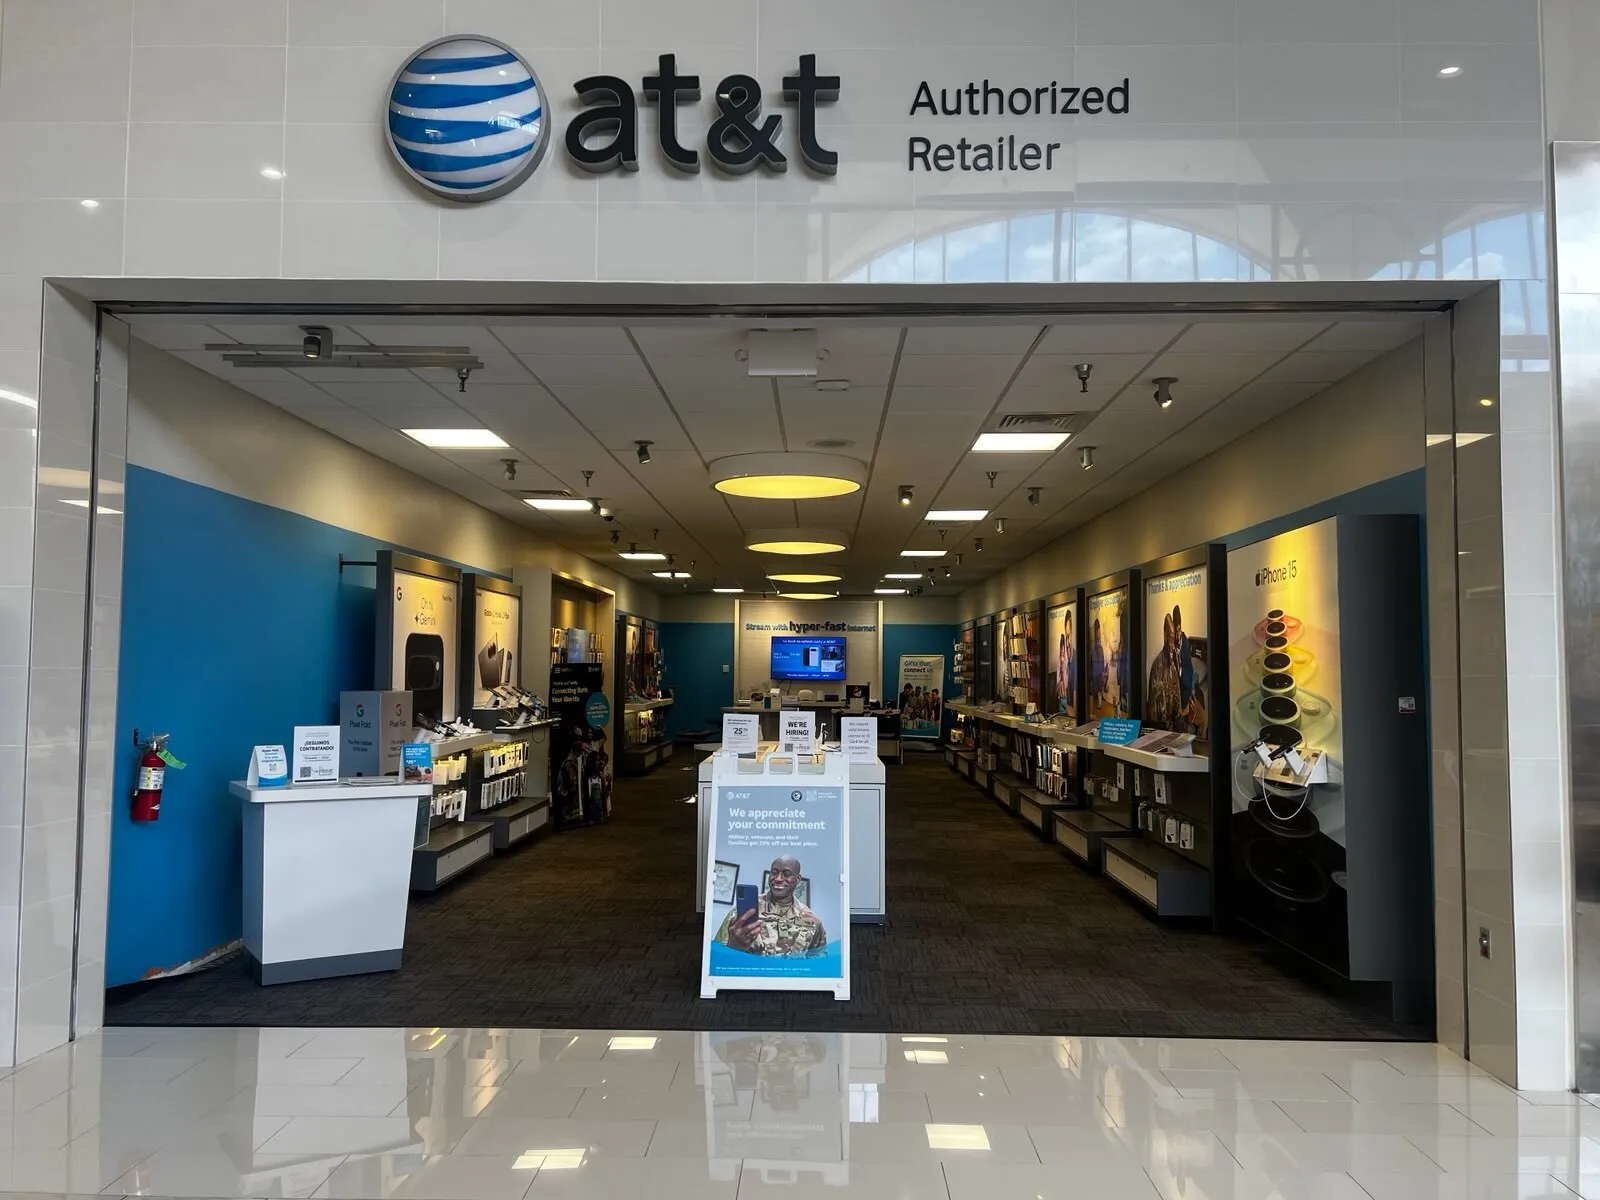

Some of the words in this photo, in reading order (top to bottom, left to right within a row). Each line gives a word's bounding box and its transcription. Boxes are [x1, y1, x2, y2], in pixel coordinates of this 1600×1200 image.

[909, 79, 1131, 115] Authorized
[565, 53, 841, 175] at&t
[908, 136, 1061, 171] Retailer
[1261, 567, 1287, 586] iPhone
[1287, 560, 1297, 580] 15
[1148, 581, 1165, 595] Thanks
[772, 623, 788, 631] with
[789, 620, 847, 633] hyper-fast
[729, 807, 746, 818] We
[748, 808, 806, 820] appreciate
[728, 821, 753, 831] your
[755, 820, 826, 830] commitment
